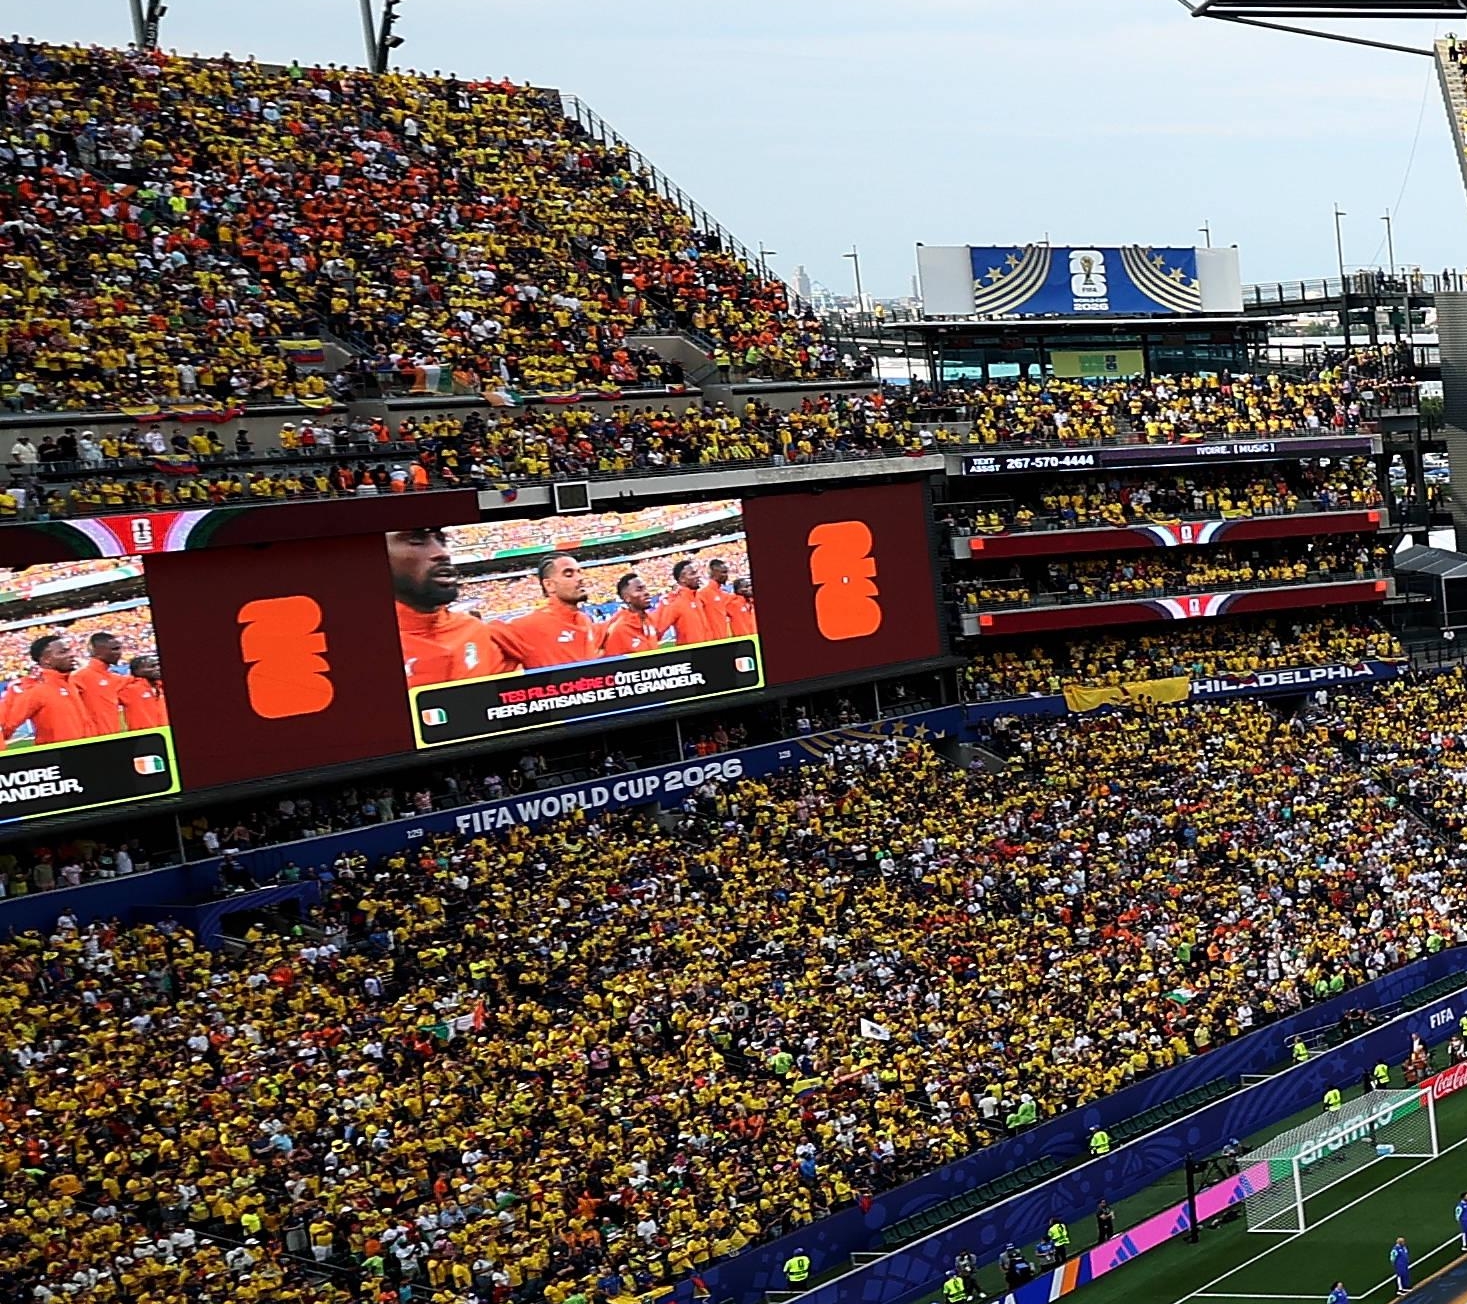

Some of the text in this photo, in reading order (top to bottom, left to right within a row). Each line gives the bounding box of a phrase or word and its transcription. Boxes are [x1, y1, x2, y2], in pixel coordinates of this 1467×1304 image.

[1073, 303, 1109, 311] 2026
[1006, 455, 1093, 470] 267-570-4444
[500, 689, 525, 704] TES
[560, 675, 604, 695] CHÈRE
[604, 670, 640, 688] CÔTE
[487, 702, 528, 720] FIERS
[528, 692, 597, 714] ARTISANS
[597, 689, 615, 702] DE
[615, 686, 634, 699] TA
[456, 758, 744, 835] FIFA WORLD CUP 2026
[1430, 1007, 1454, 1029] FIFA
